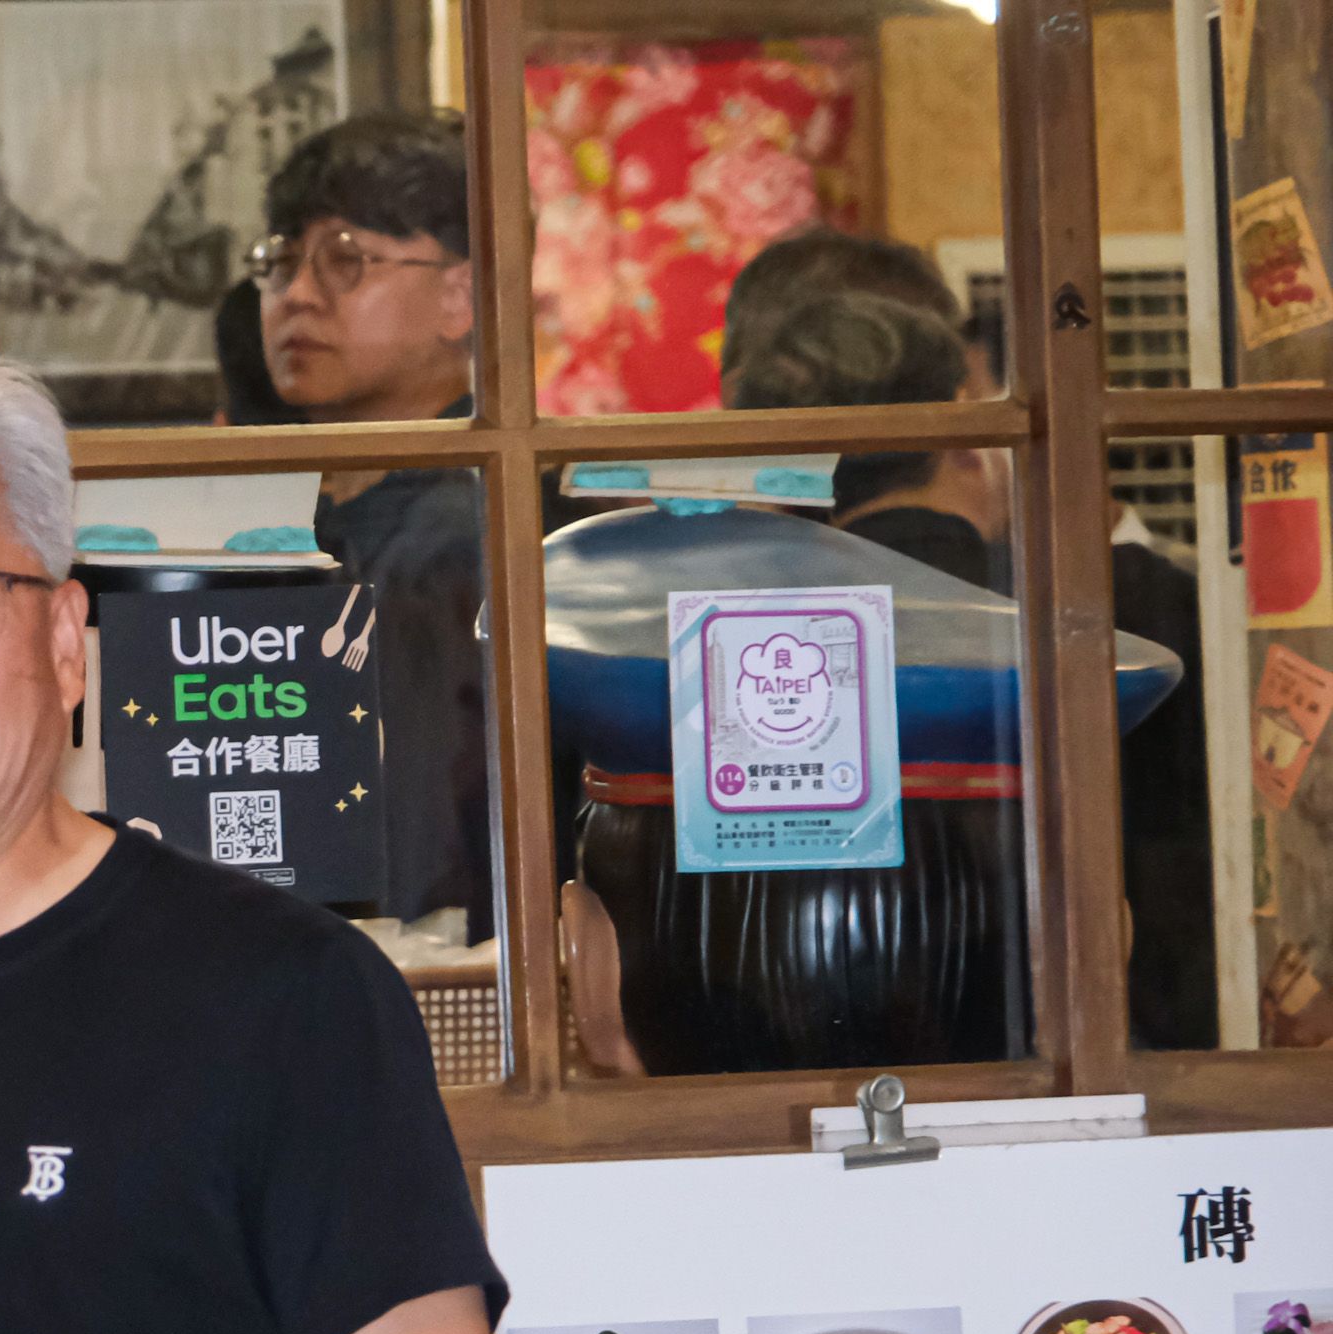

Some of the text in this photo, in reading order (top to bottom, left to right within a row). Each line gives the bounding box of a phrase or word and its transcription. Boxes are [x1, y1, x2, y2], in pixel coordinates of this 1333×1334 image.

[170, 616, 305, 665] Uber
[173, 673, 307, 722] Eats
[751, 676, 812, 695] TAIPEI
[166, 733, 321, 777] 合作餐廳
[718, 771, 743, 783] 114
[1177, 1186, 1254, 1264] 磚
